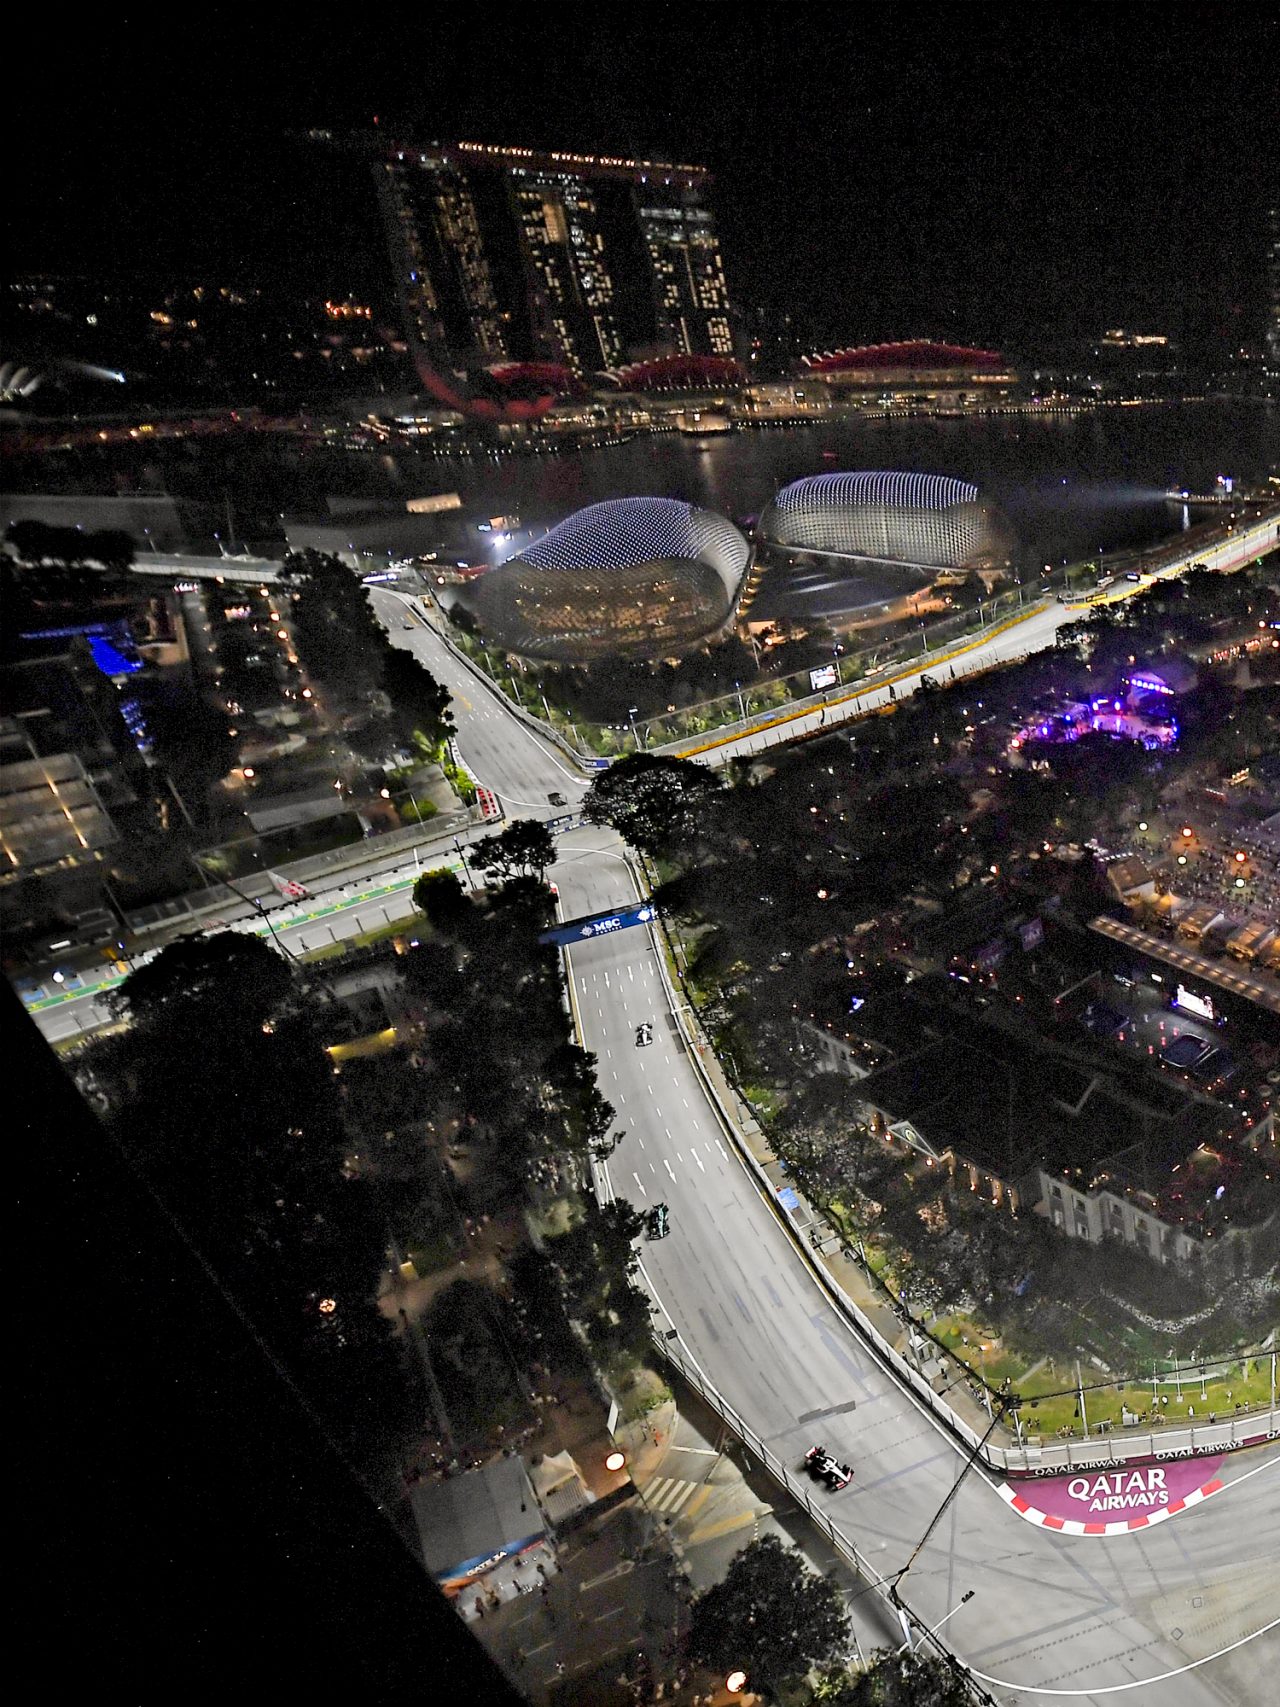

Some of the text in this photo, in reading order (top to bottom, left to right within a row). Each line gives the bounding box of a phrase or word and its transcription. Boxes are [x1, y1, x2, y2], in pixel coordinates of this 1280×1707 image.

[593, 918, 621, 931] MSC
[1156, 1440, 1244, 1460] QATAR AIRWAYS
[1035, 1458, 1127, 1476] QATAR AIRWAYS
[1067, 1468, 1167, 1501] QATAR
[1089, 1490, 1169, 1512] AIRWAYS
